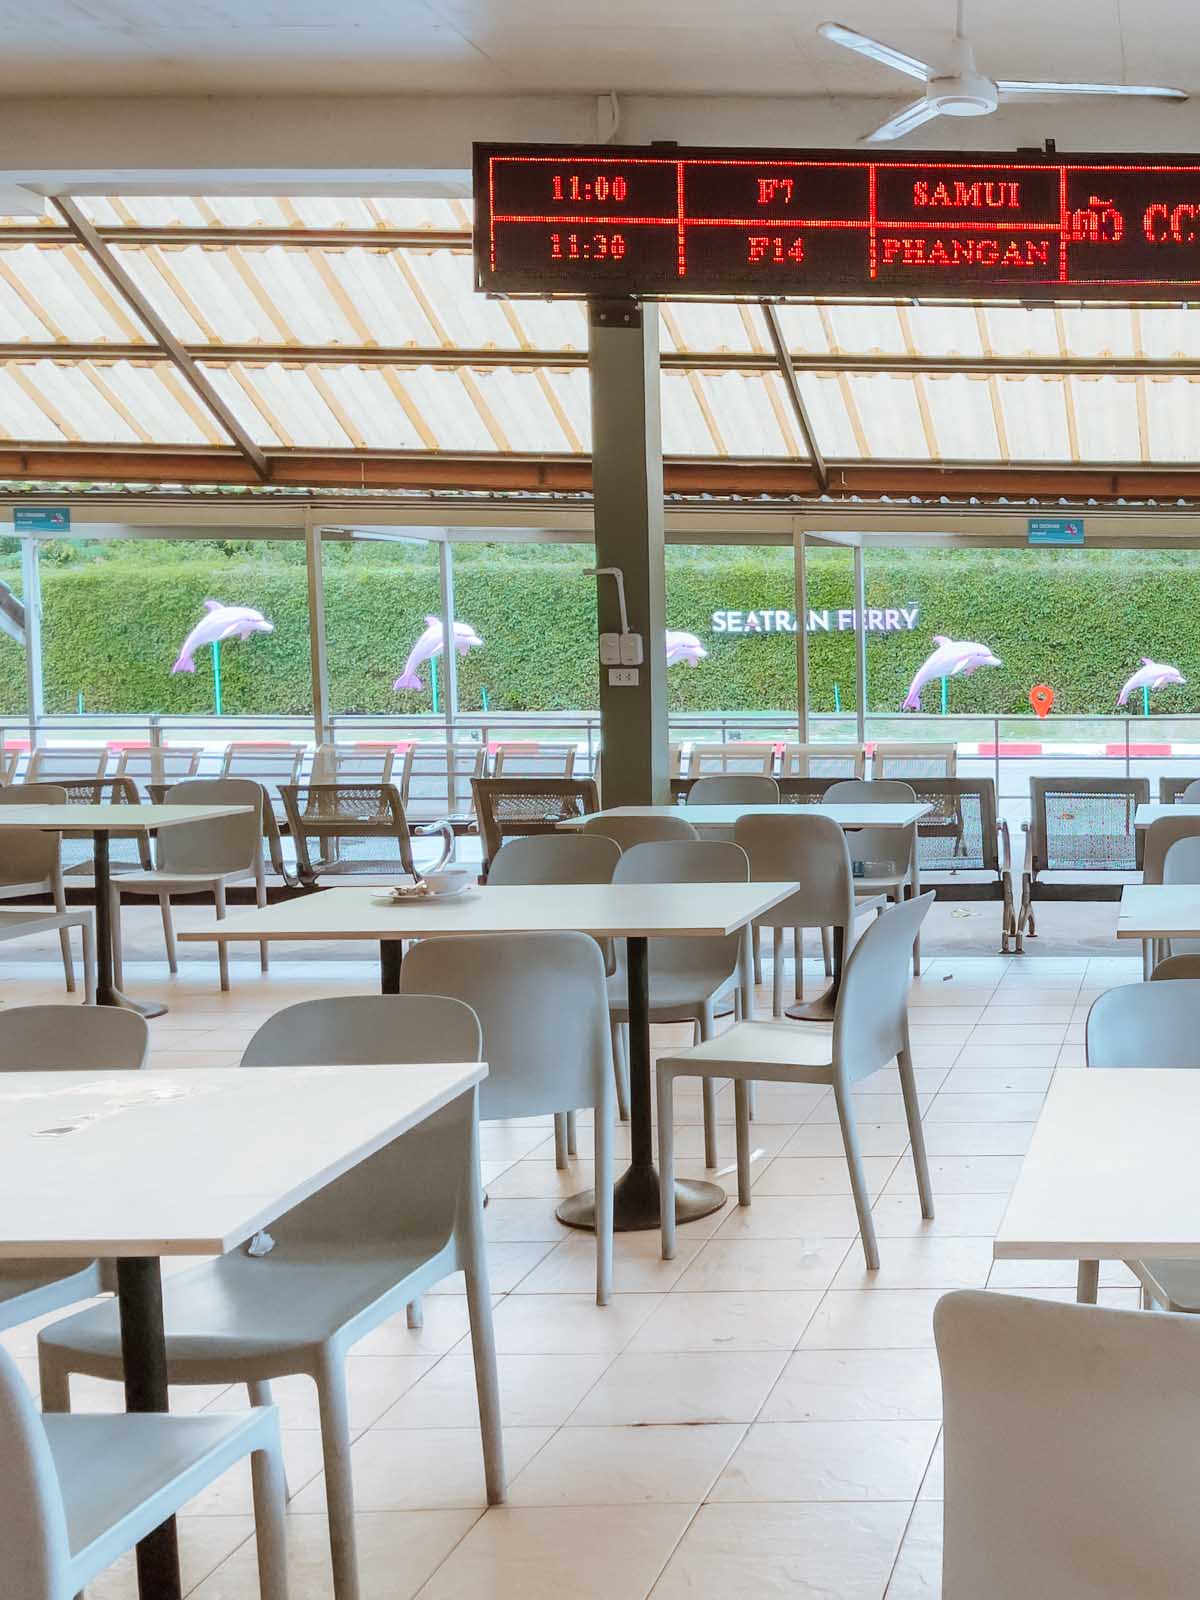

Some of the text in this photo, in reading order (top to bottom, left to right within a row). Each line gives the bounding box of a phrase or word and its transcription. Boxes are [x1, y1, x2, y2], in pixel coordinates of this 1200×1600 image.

[551, 175, 628, 202] 11:00
[757, 178, 794, 205] F7
[912, 181, 1021, 209] SAMUI
[549, 233, 626, 261] 11:30
[748, 236, 805, 264] F14
[881, 238, 1050, 266] PHANGAN
